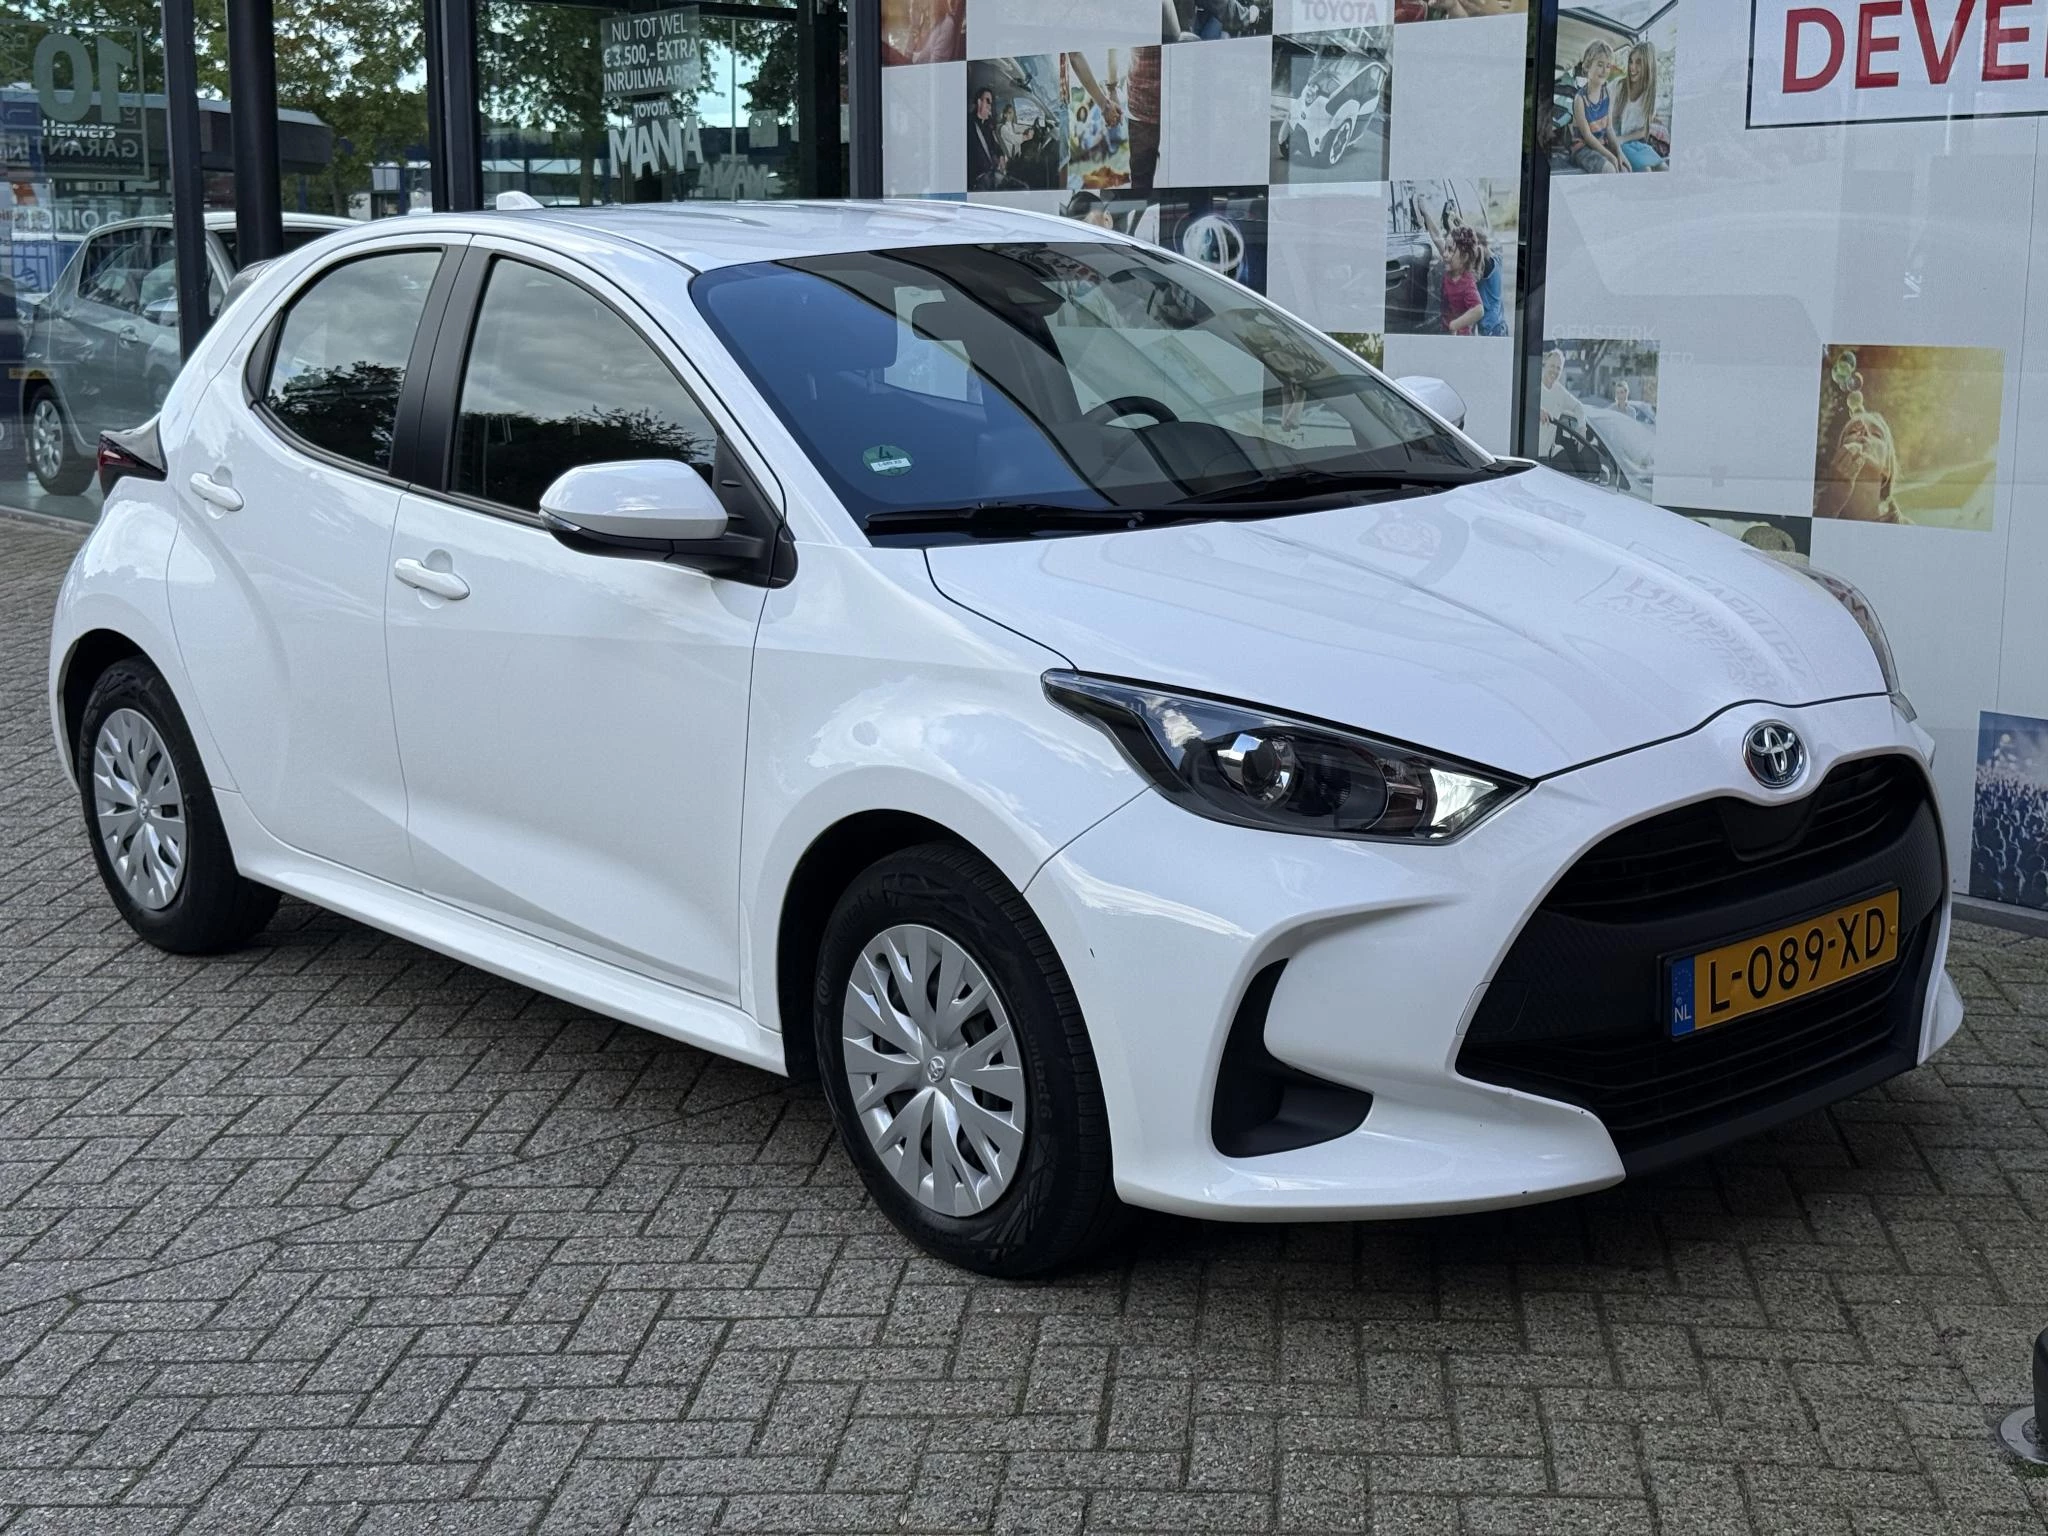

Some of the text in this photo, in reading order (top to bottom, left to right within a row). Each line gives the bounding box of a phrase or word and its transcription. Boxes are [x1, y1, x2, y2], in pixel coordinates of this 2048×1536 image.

[1301, 0, 1378, 24] TOYOTA
[612, 13, 688, 42] NU TOT WEL
[1783, 0, 2048, 93] DEVE
[604, 63, 699, 92] INRUILWAAR
[633, 101, 671, 118] TOYOTA
[42, 118, 118, 139] Herwers
[608, 114, 705, 180] MANIA
[1710, 907, 1886, 1014] L-089-XD
[1674, 1004, 1692, 1023] NL
